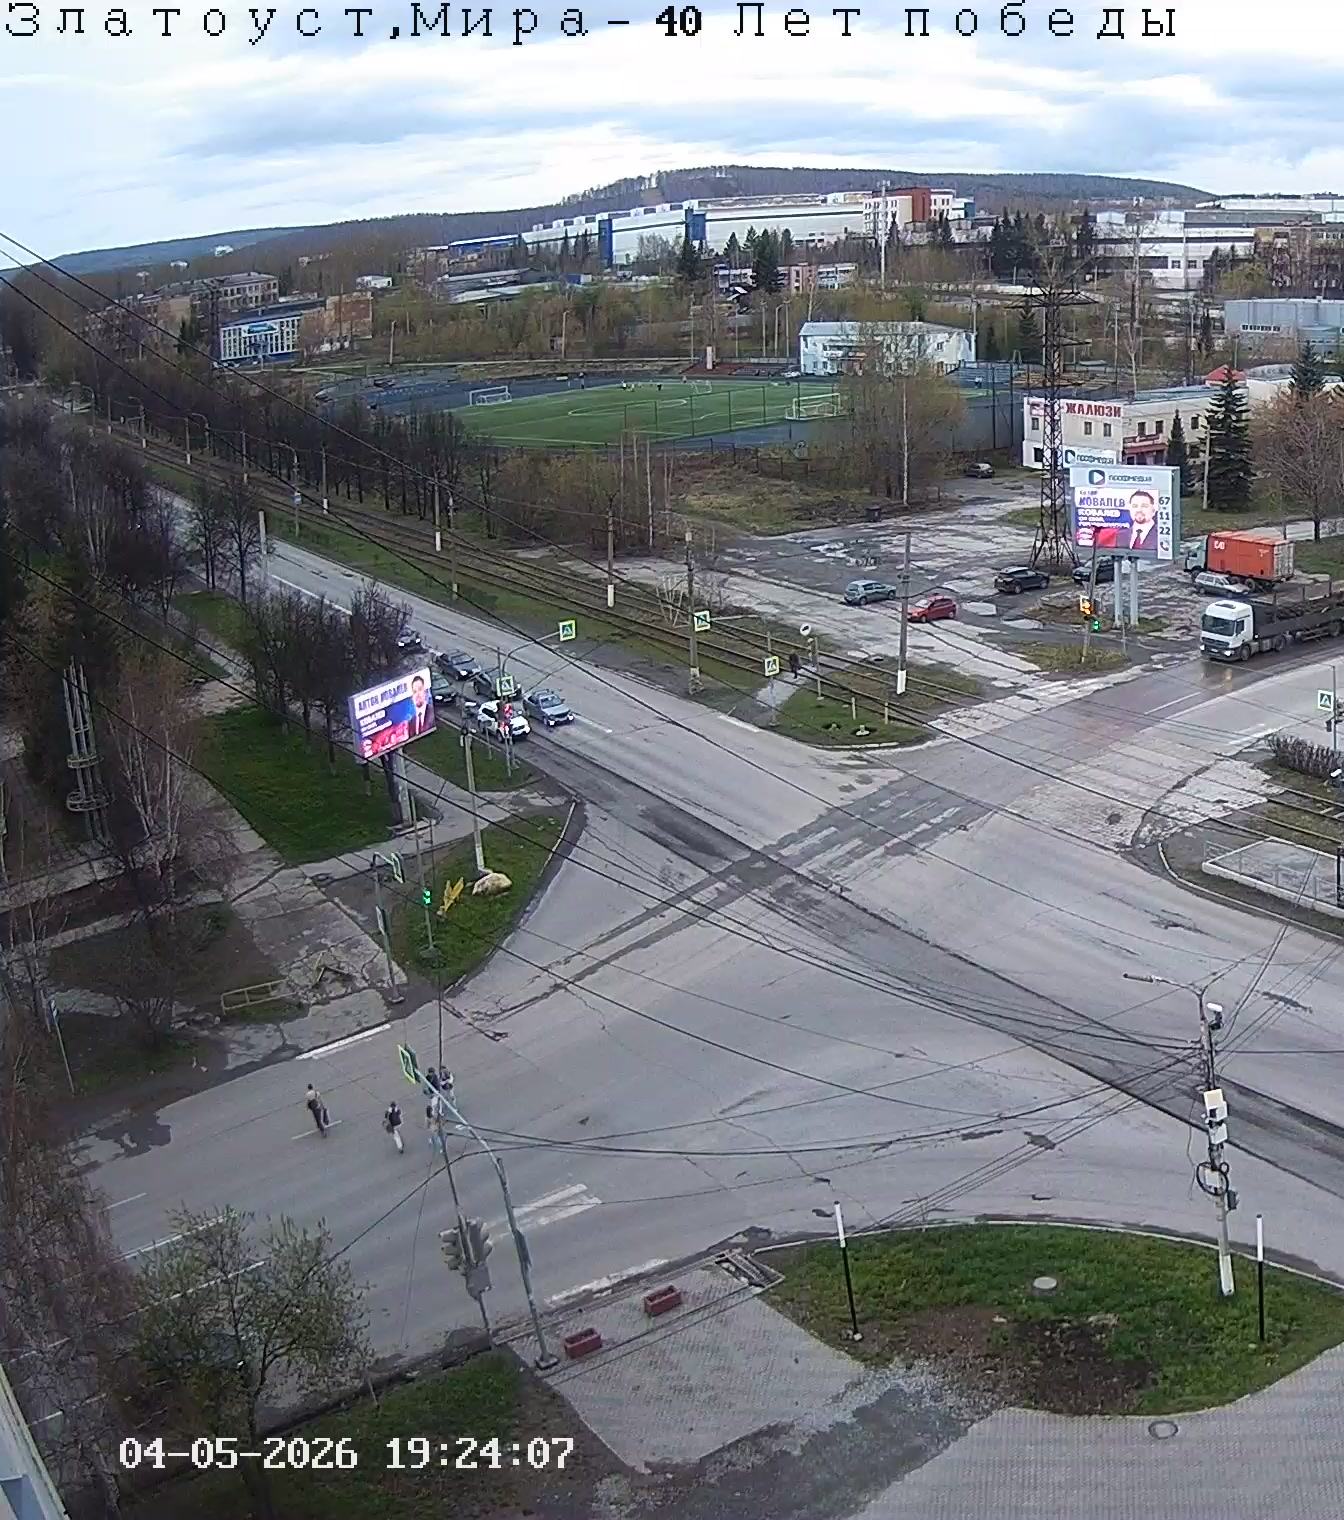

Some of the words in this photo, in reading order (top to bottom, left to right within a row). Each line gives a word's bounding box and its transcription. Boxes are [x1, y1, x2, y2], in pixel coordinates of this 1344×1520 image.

[1065, 402, 1122, 418] ЖАЛЮЗИ
[1158, 496, 1171, 506] 67
[1159, 512, 1170, 520] 11
[1159, 527, 1171, 536] 22
